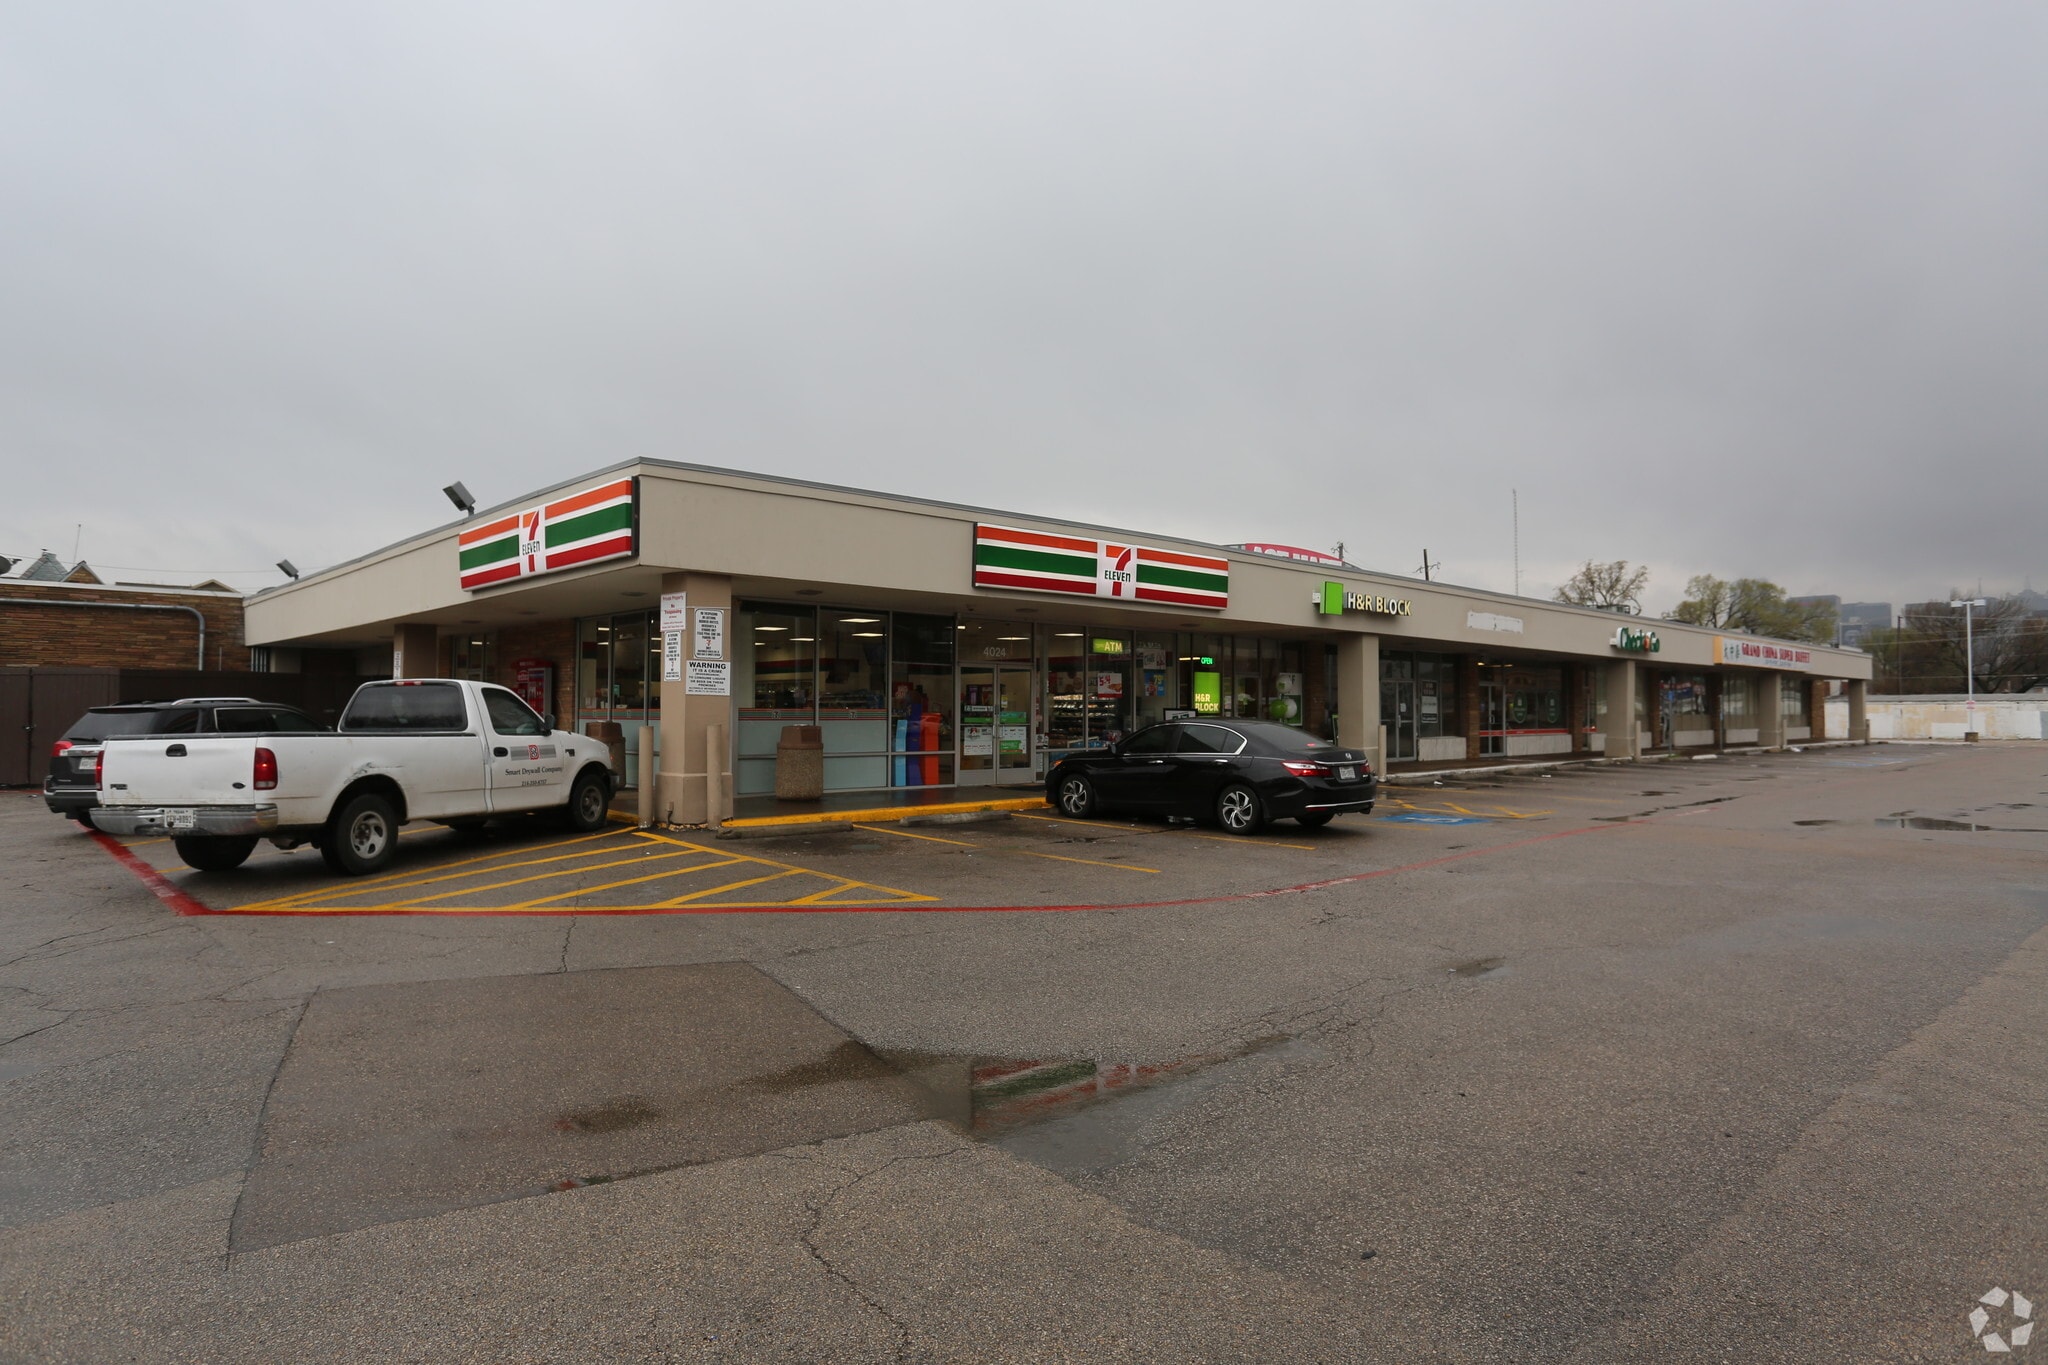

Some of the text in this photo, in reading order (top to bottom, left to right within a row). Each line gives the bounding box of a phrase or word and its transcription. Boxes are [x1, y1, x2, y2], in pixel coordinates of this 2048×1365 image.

[1347, 592, 1412, 616] H&R BLOCK
[1104, 641, 1123, 652] ATM
[983, 647, 1007, 657] 4024
[1741, 642, 1760, 658] GRAND
[1762, 645, 1778, 660] CHINA
[1779, 648, 1794, 662] SUPER
[1795, 650, 1811, 664] BUFFET
[689, 661, 727, 670] WARNING
[1200, 657, 1213, 665] OPEN
[1194, 693, 1211, 703] H&R
[1194, 702, 1219, 712] BLOCK
[521, 767, 540, 776] Drywall
[541, 766, 563, 774] Company
